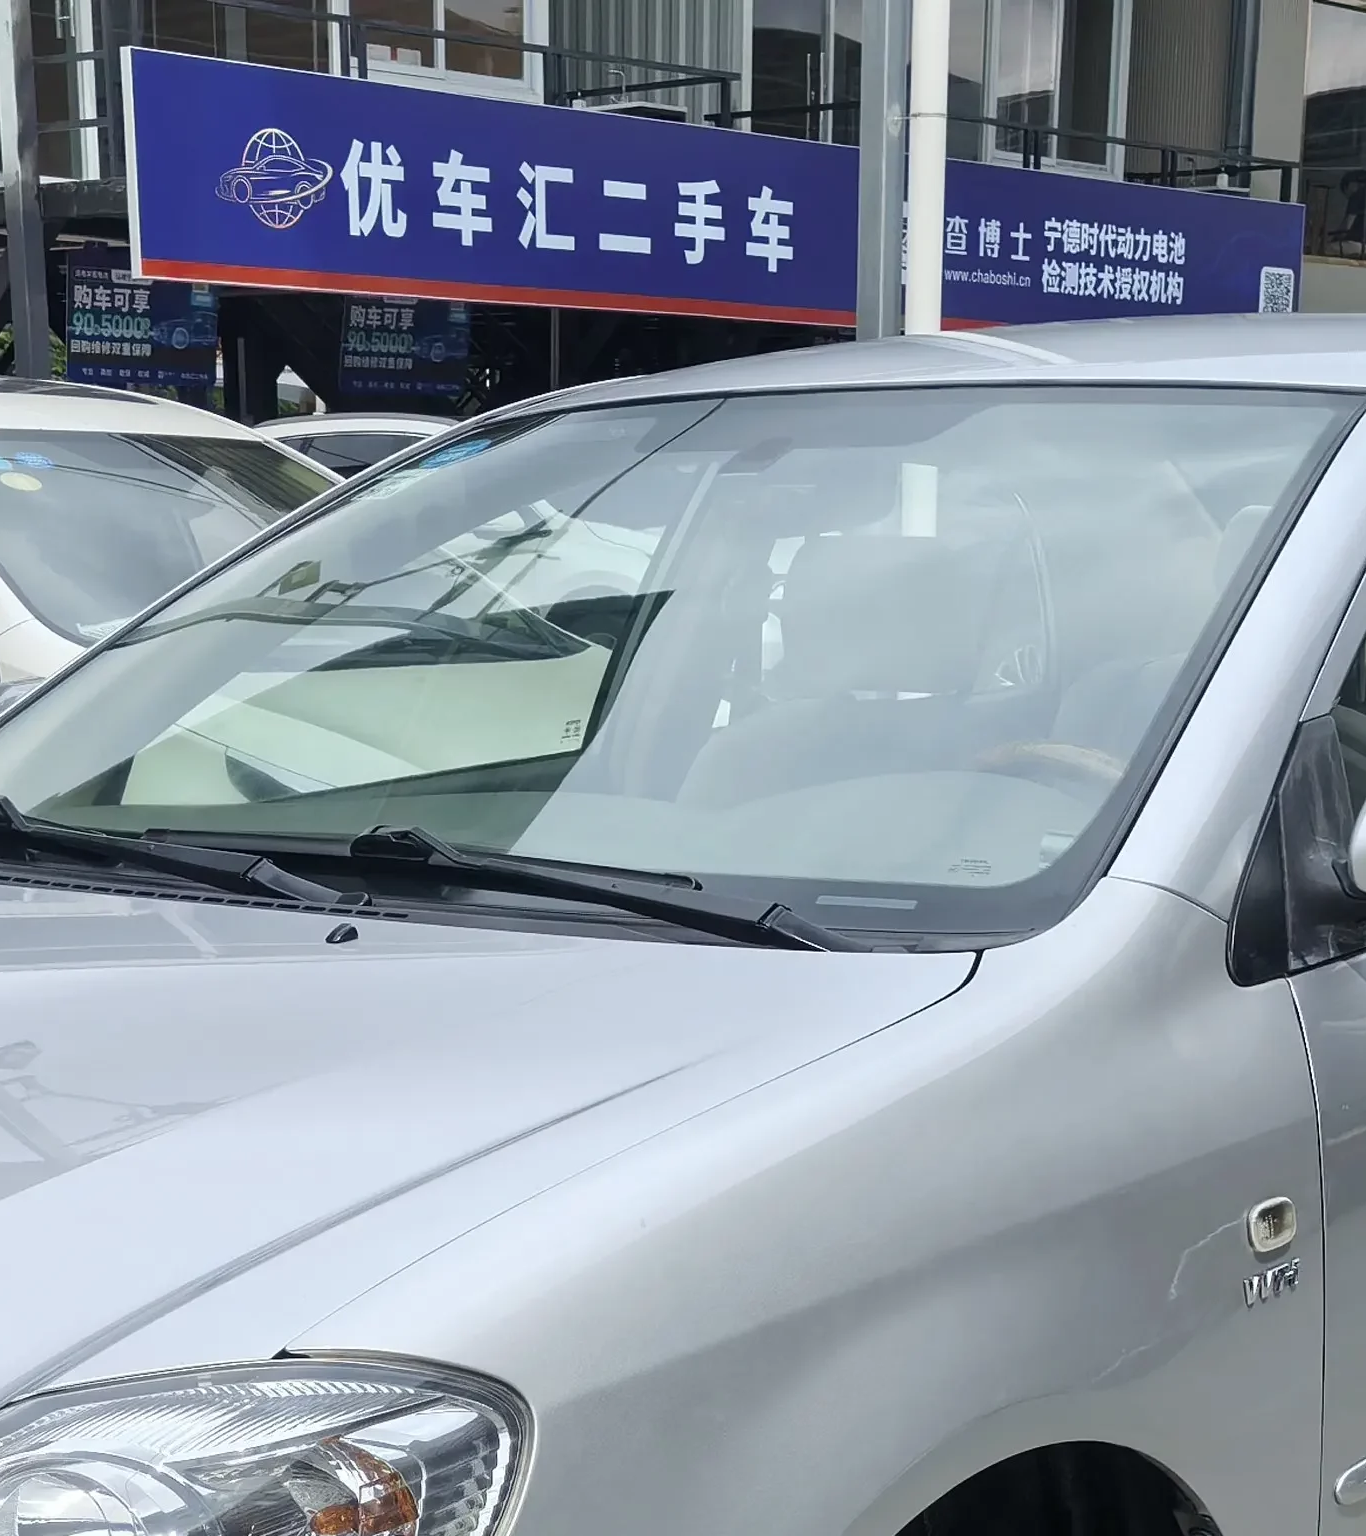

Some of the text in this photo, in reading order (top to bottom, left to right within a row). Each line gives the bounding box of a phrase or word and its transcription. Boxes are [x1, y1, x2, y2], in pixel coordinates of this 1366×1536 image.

[339, 138, 795, 273] 优车汇二手车
[944, 215, 1032, 261] 查博士
[1044, 217, 1186, 265] 宁德时代动力电池
[73, 284, 151, 313] 购车可享
[944, 268, 1031, 287] www.chaboshi.cn
[1042, 258, 1184, 305] 检测技术授权机构
[349, 305, 415, 330] 购车可享
